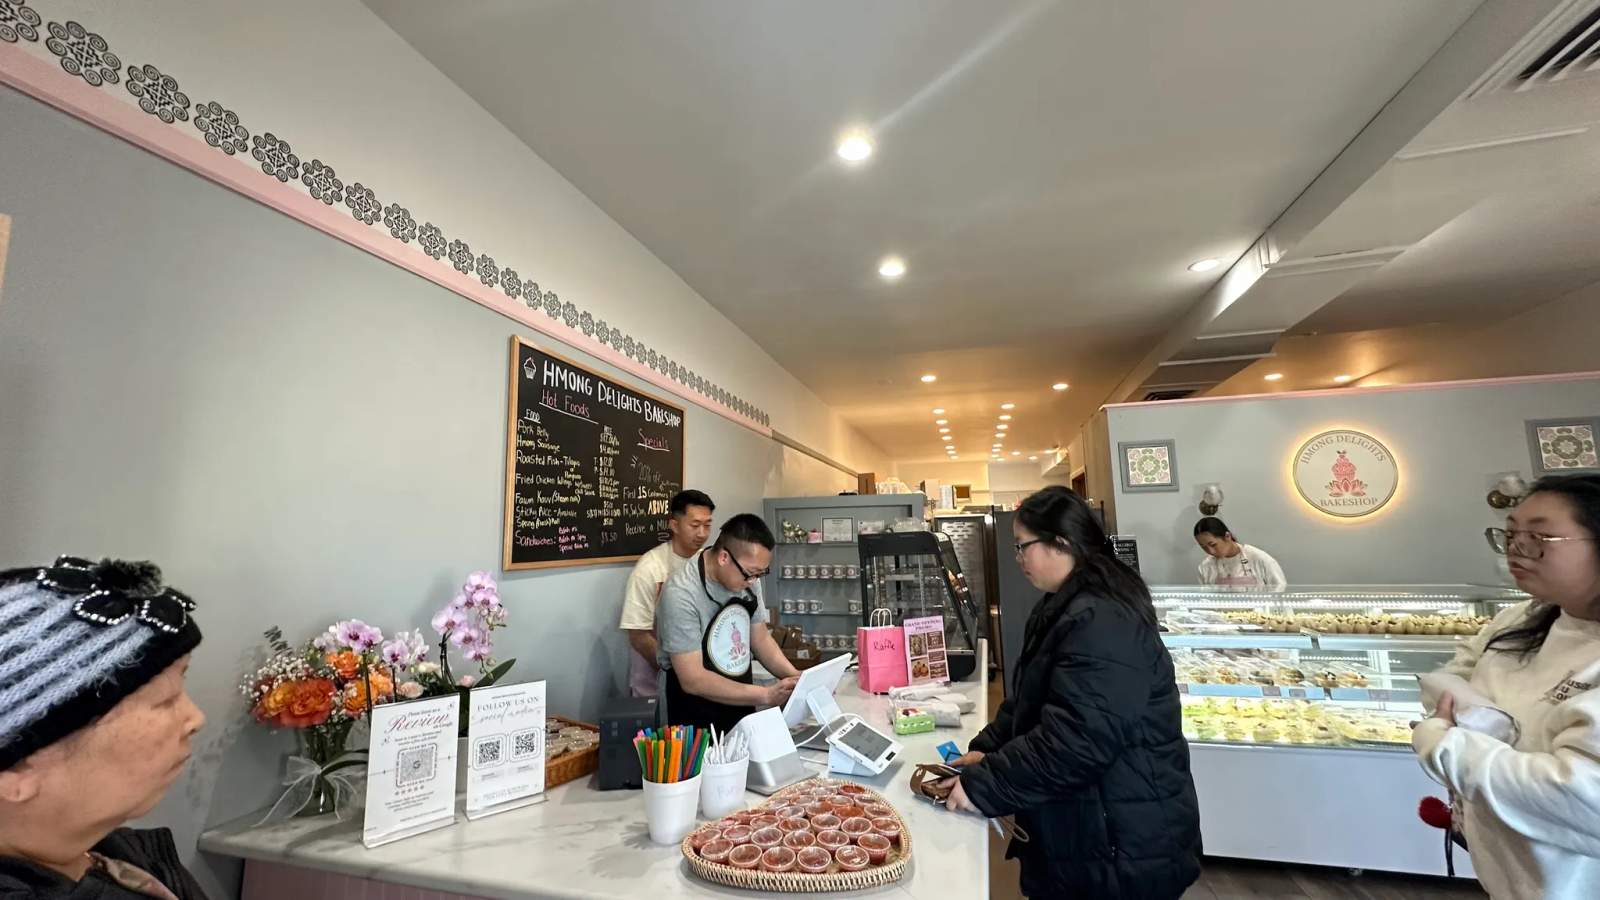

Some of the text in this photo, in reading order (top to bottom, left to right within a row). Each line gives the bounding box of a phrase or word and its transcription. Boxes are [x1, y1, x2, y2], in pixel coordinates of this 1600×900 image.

[542, 389, 590, 418] Hot Foods
[543, 360, 681, 427] HMONG DELIGHTS BAKESHOP
[517, 419, 549, 441] Pork Belly
[638, 428, 670, 450] Specials
[516, 434, 561, 454] Hmong Sausage
[1300, 434, 1387, 464] HMONG DELIGHTS
[516, 449, 545, 466] Roasted
[516, 473, 534, 484] Fried
[535, 475, 555, 485] Chicken
[637, 486, 647, 499] 15
[1320, 497, 1378, 507] BAKESHOP
[625, 522, 646, 536] Receive
[477, 699, 511, 712] FOLLOW
[384, 713, 449, 734] Review
